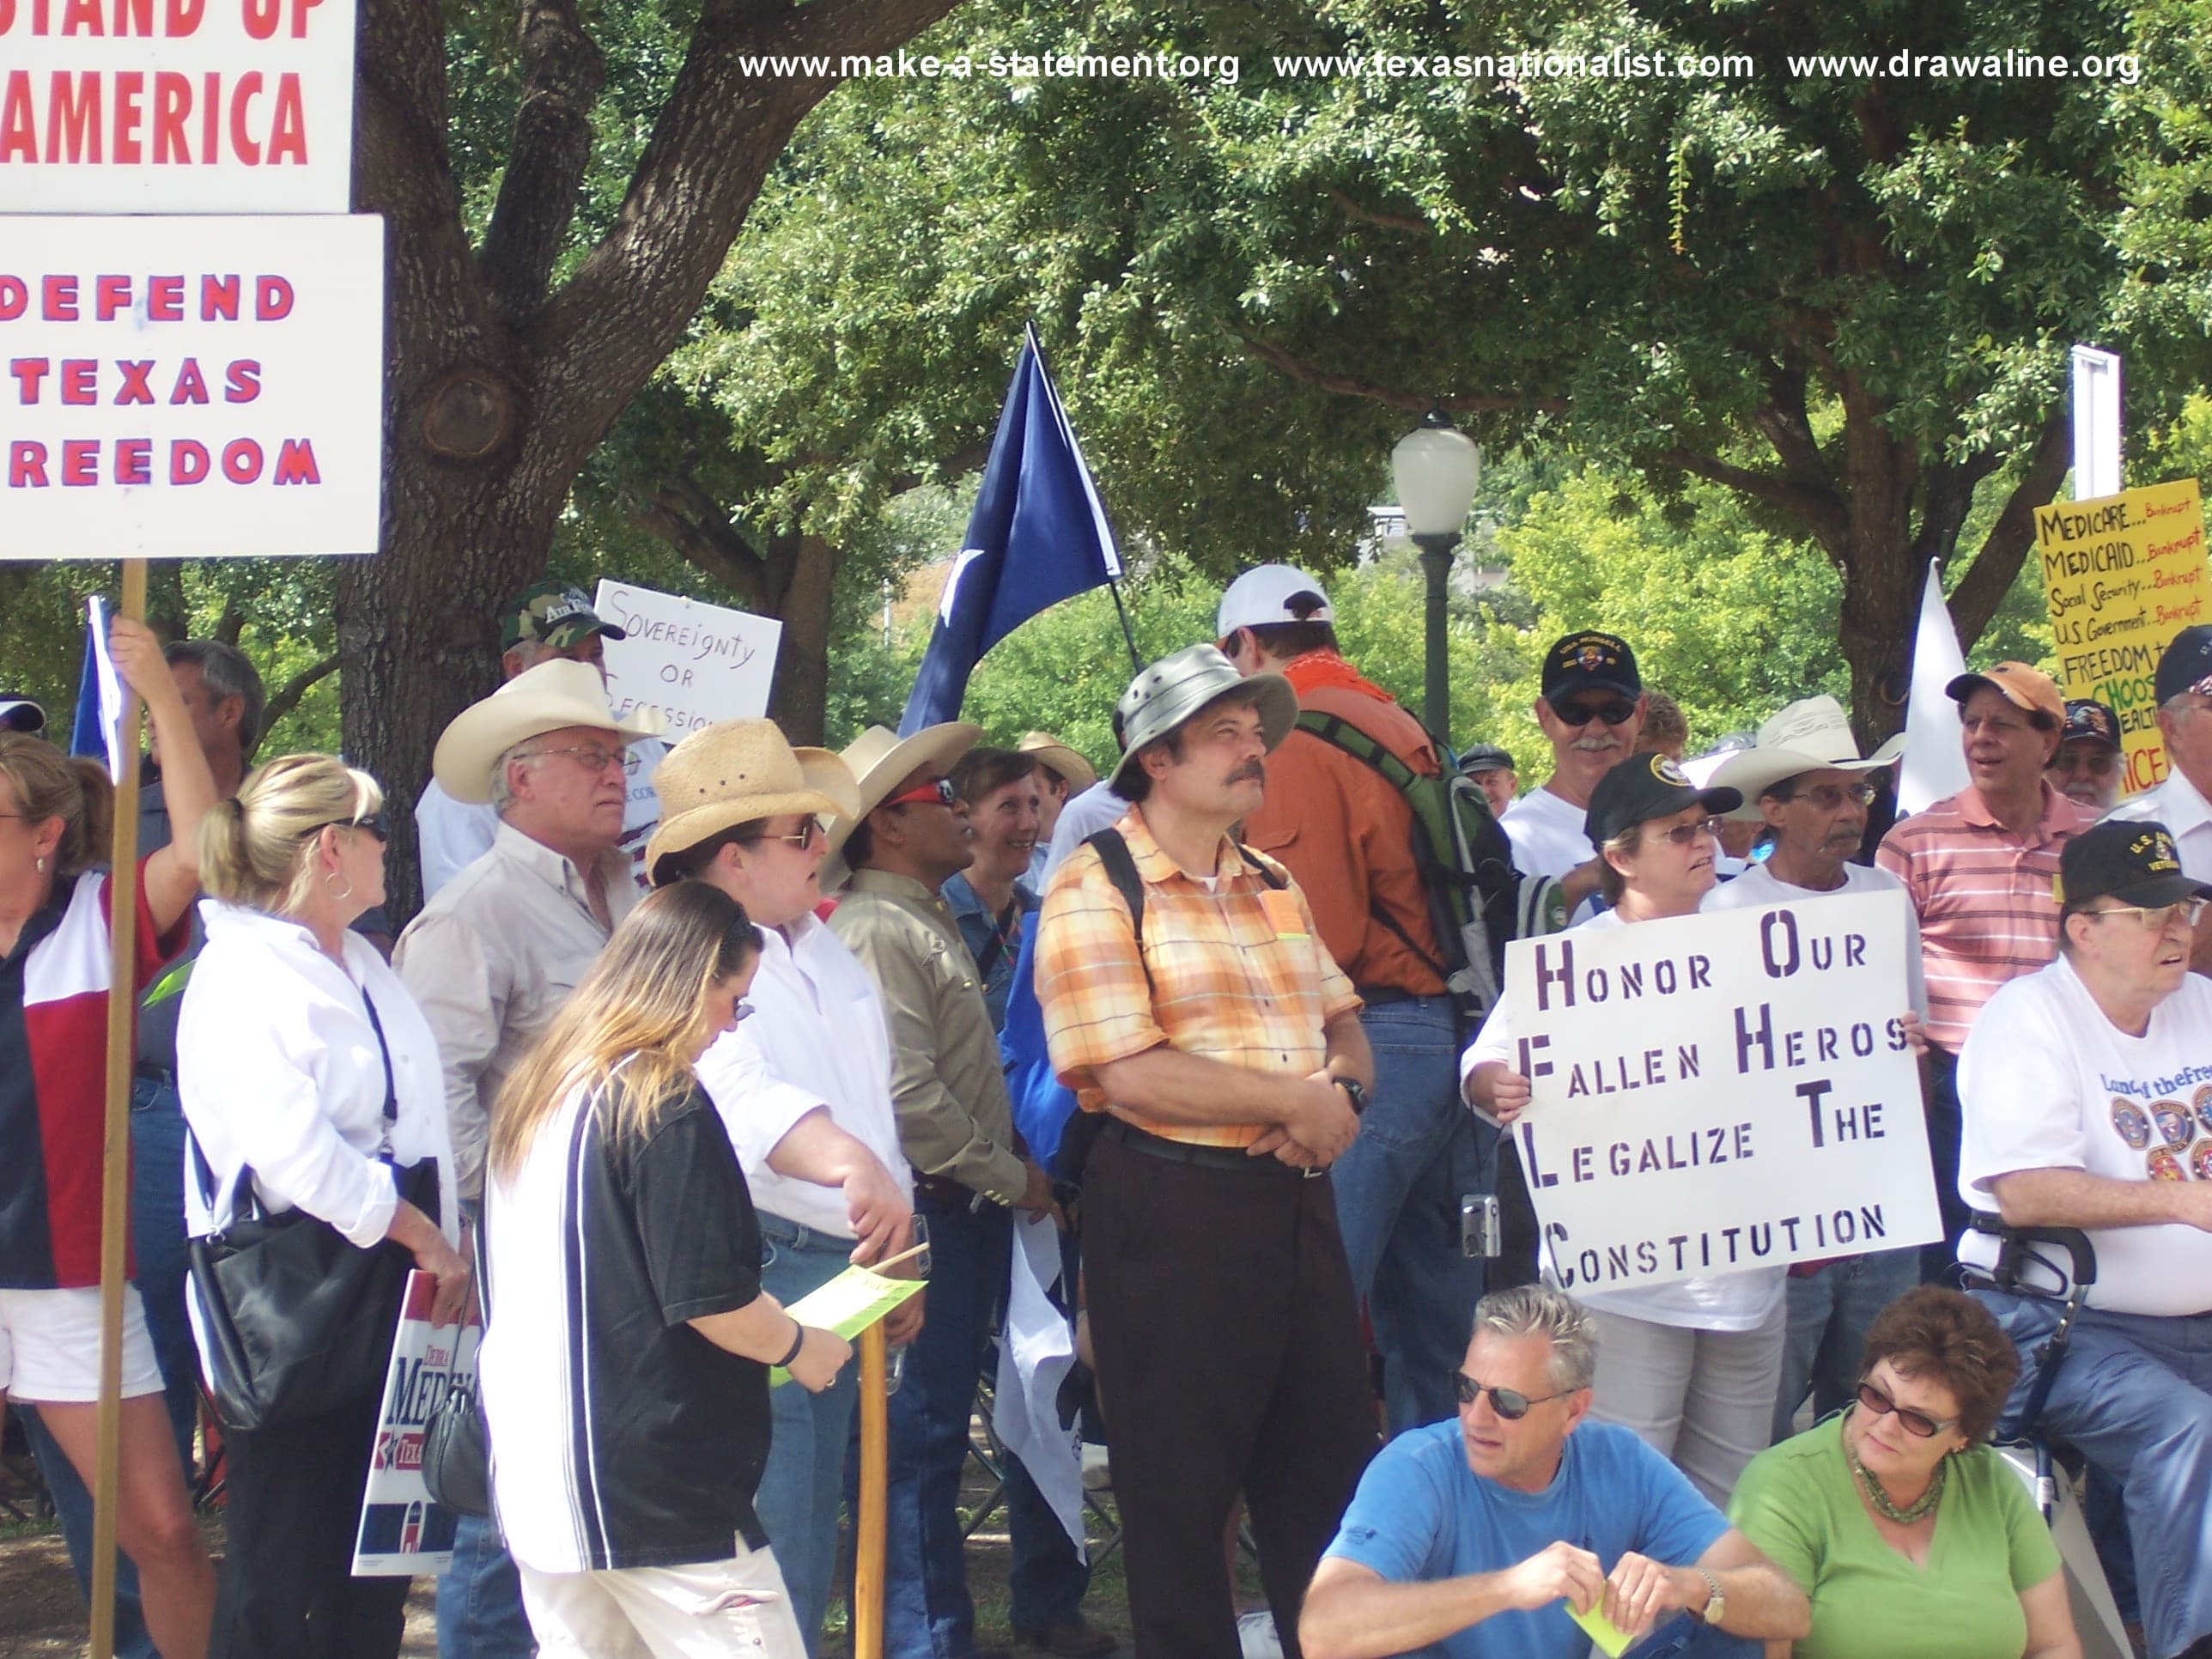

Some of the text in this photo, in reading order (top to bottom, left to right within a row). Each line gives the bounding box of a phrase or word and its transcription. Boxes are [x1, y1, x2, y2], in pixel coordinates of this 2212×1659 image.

[0, 0, 207, 38] AND
[0, 70, 308, 166] AMERICA
[0, 275, 295, 322] DEFEND
[10, 358, 261, 406] TEXAS
[2051, 584, 2086, 617] Social
[659, 664, 694, 688] OR
[2064, 644, 2154, 685] FREEDOM
[2120, 706, 2158, 734] EALT
[1535, 909, 1868, 1012] HONOR OUR
[1517, 1003, 1907, 1099] FALLEN HEROS
[1523, 1079, 1887, 1190] LEGALIZE THE
[1545, 1204, 1887, 1290] CONSTITUTION
[386, 1357, 477, 1425] MED
